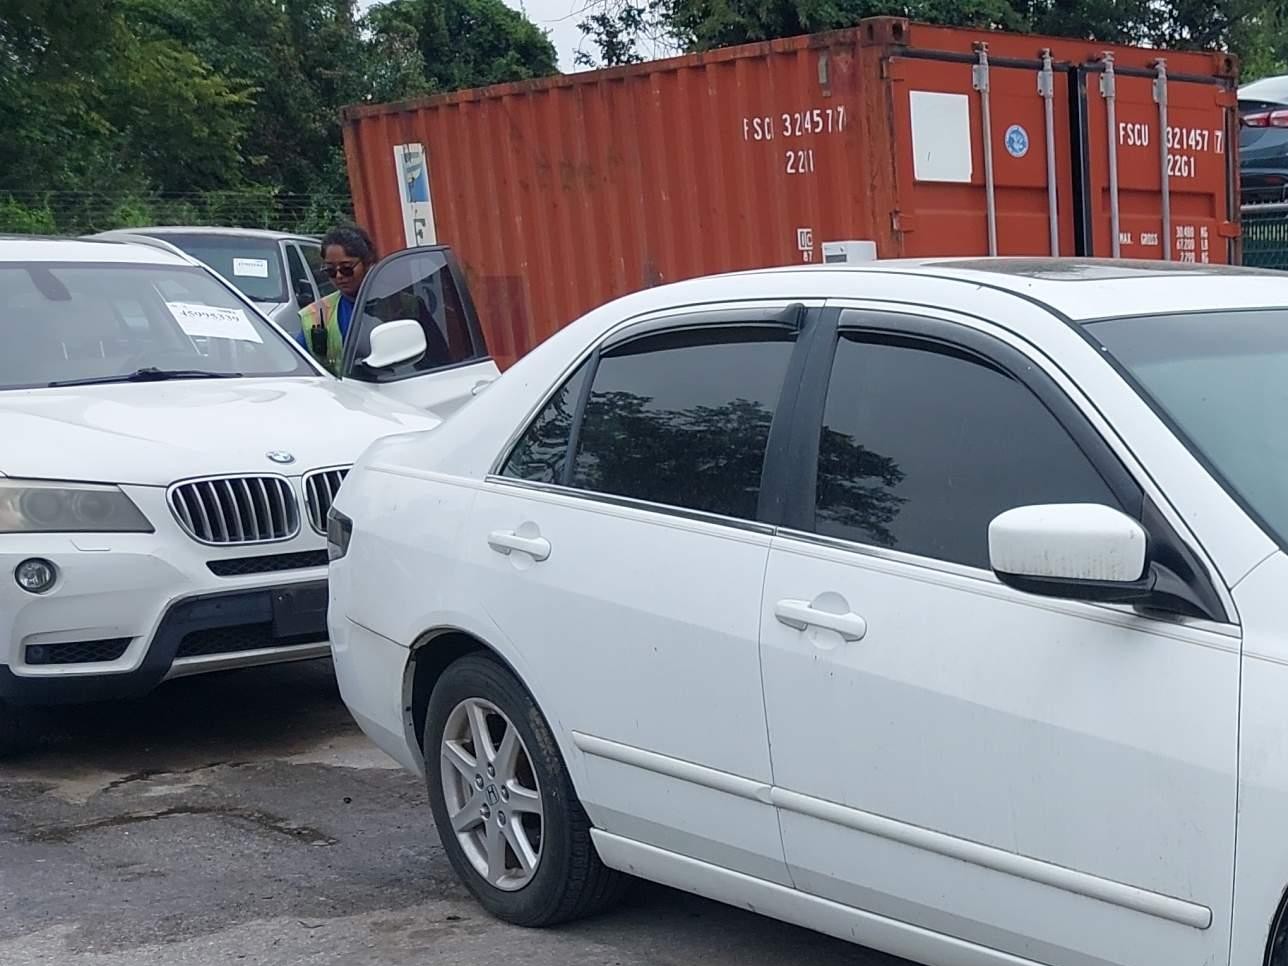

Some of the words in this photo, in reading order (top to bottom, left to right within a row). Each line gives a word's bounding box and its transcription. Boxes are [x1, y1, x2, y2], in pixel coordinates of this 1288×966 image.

[1119, 122, 1149, 147] FSCU
[1166, 126, 1209, 151] 321457
[1214, 130, 1224, 153] 7
